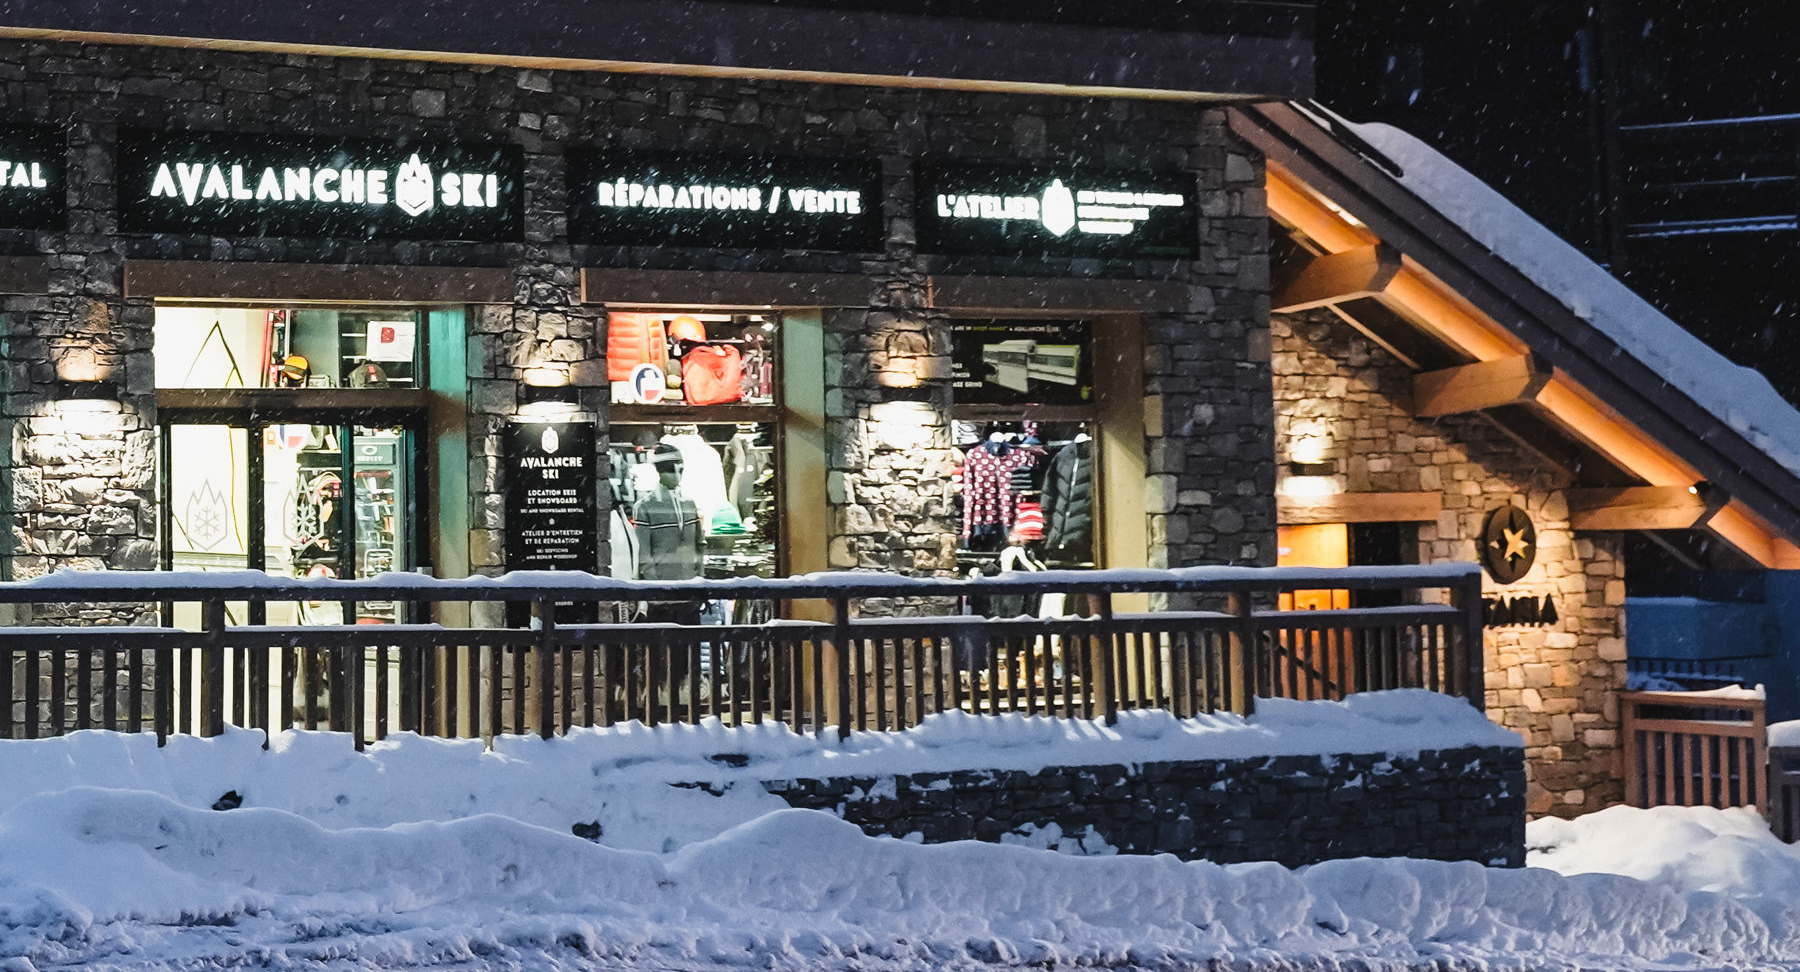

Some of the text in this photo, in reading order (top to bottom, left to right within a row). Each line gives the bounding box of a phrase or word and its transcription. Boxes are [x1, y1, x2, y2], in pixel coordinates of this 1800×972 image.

[150, 161, 498, 208] AVALANCHE SKI
[597, 176, 862, 215] RÉPARATIONS / VENTE
[937, 193, 1040, 221] L'ATELIER
[520, 457, 583, 469] AVALANCHE
[542, 469, 559, 479] SKI
